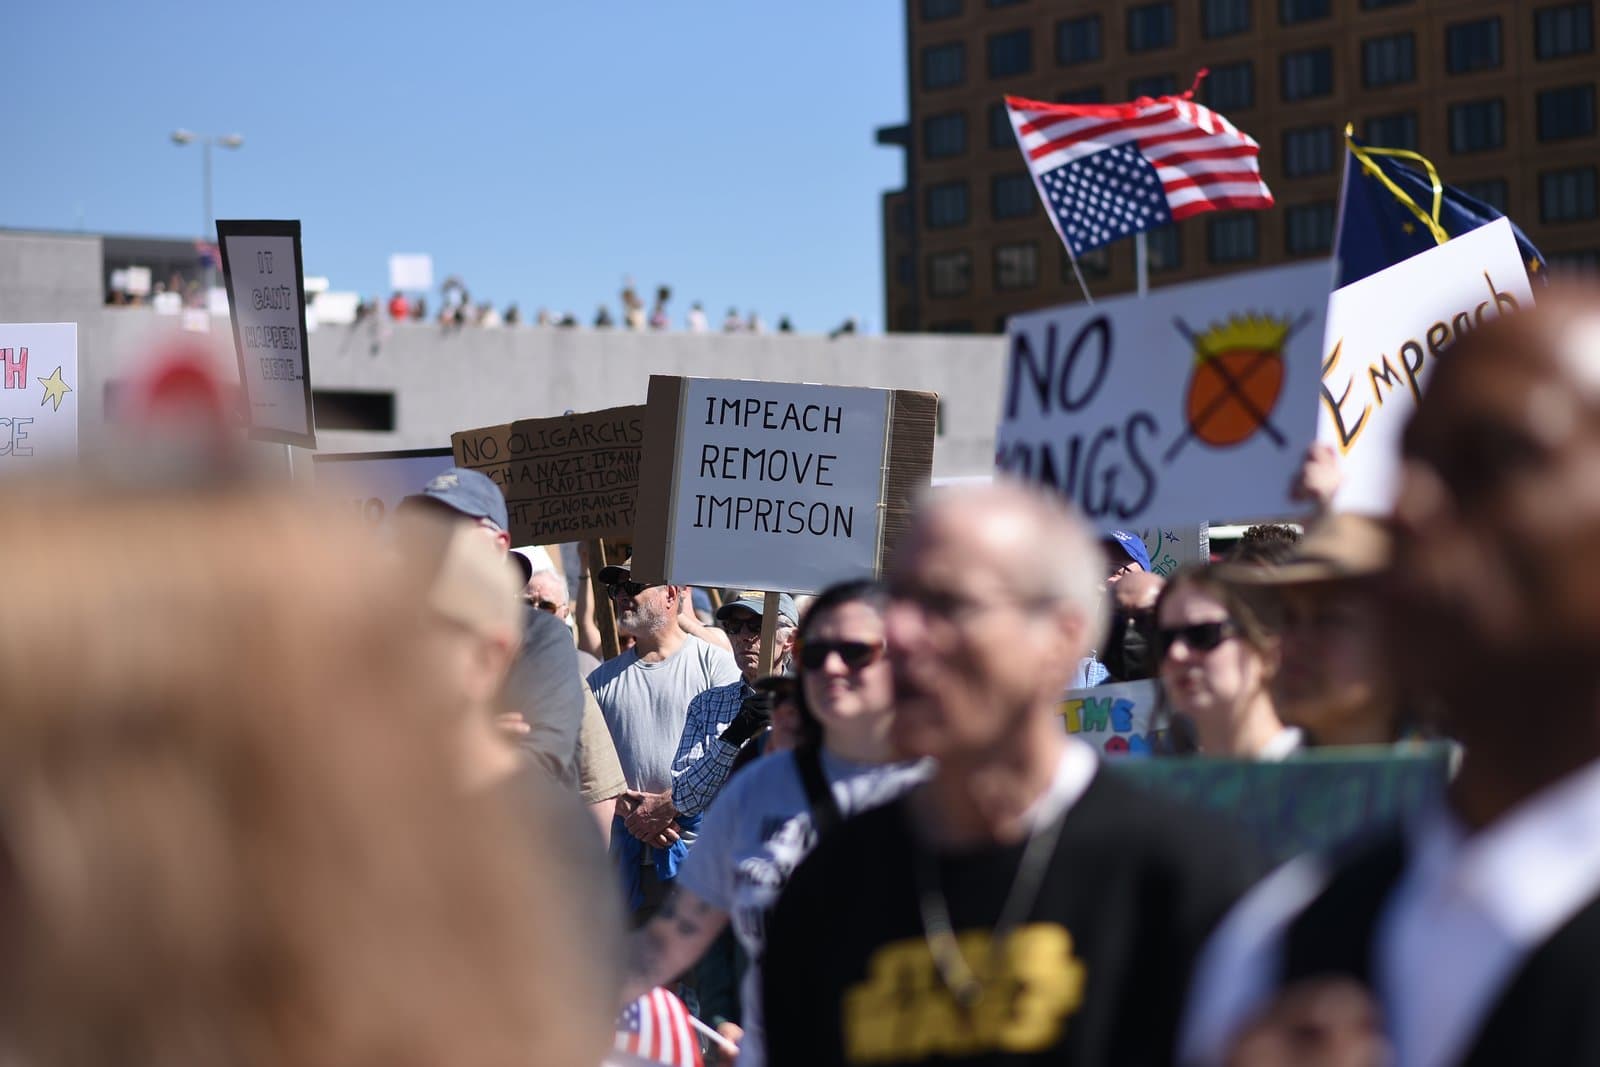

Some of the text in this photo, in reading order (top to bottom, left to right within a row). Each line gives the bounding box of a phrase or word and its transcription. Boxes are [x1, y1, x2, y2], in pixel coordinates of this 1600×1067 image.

[257, 251, 273, 274] IT
[244, 326, 297, 350] HAPPEN
[1004, 312, 1114, 421] NO
[705, 396, 842, 434] IMPEACH
[461, 419, 643, 464] NO OLIGARCHS
[520, 463, 533, 483] A
[699, 444, 837, 486] REMOVE
[995, 410, 1160, 522] INGS
[530, 508, 637, 538] IMMIGRANT
[692, 494, 854, 538] IMPRISON
